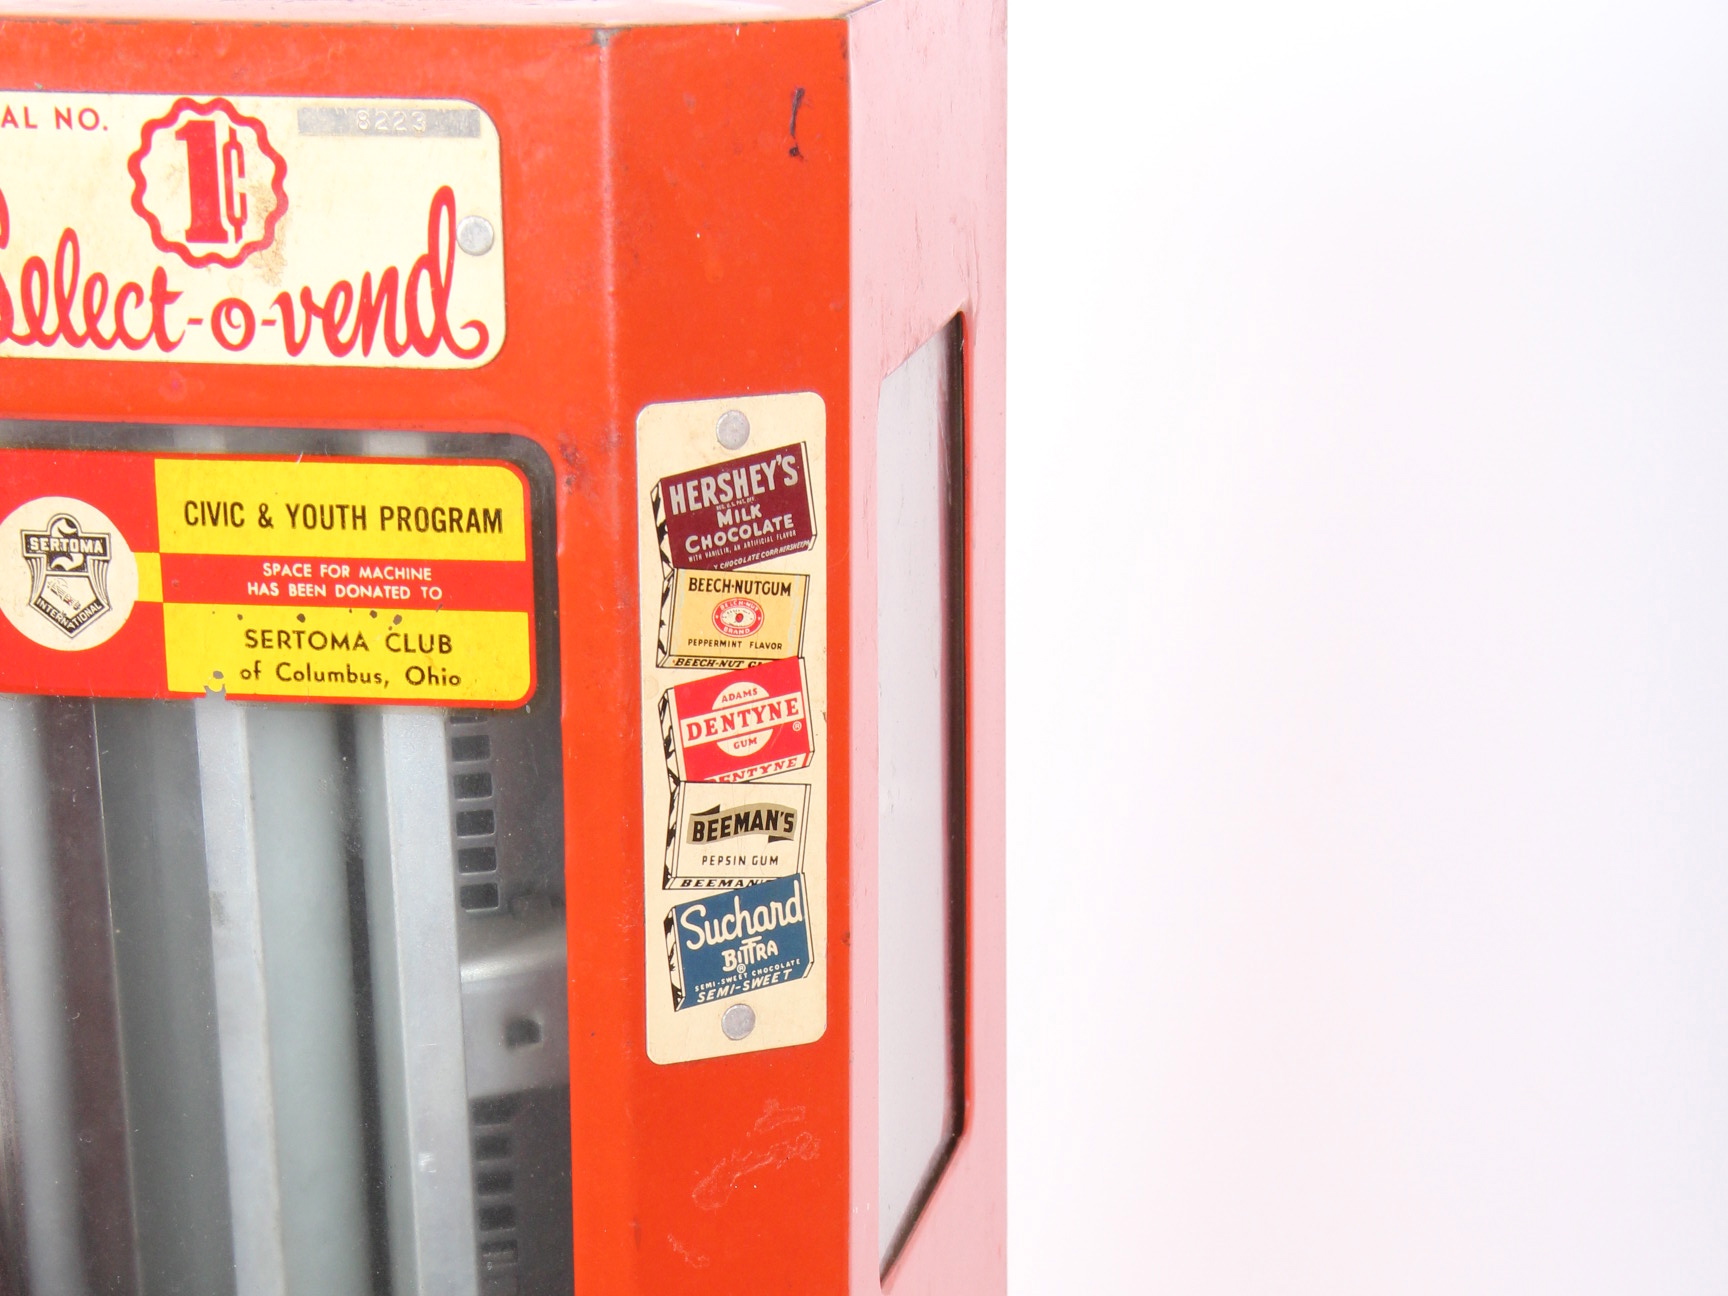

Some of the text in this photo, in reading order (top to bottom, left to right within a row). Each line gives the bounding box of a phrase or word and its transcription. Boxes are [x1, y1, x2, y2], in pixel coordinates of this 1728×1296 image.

[54, 106, 109, 131] NO.
[357, 109, 426, 131] 8223
[669, 454, 799, 515] HERSHEY'S
[184, 500, 503, 534] CIVIC & YOUTH PROGRAM
[717, 503, 762, 528] MILK
[29, 537, 104, 554] SERTOMA
[685, 514, 794, 554] CHOCOLATE
[688, 554, 702, 562] WITH
[776, 530, 796, 540] FLAVOR
[262, 562, 432, 581] SPACE FOR MACHINE
[720, 552, 760, 570] CHOCOLATE
[247, 580, 443, 601] HAS BEEN DONATED TO
[36, 598, 102, 629] INTERNATIONAL
[244, 629, 452, 655] SERTOMA CLUB
[723, 627, 750, 635] BRAND
[687, 638, 782, 650] PEPPERMINT FLAVOR
[240, 662, 462, 689] of Columbus, Ohio
[721, 688, 758, 703] ADAMS
[686, 697, 799, 741] DENTYNE
[733, 737, 758, 749] GUM
[692, 809, 795, 842] BEEMAN'S
[702, 855, 778, 866] PEPSIN GUM
[680, 880, 803, 950] Suchard
[694, 958, 800, 992] SEMI-SWEET CHOCOLATE
[697, 969, 792, 1003] SEMI-SWEET
